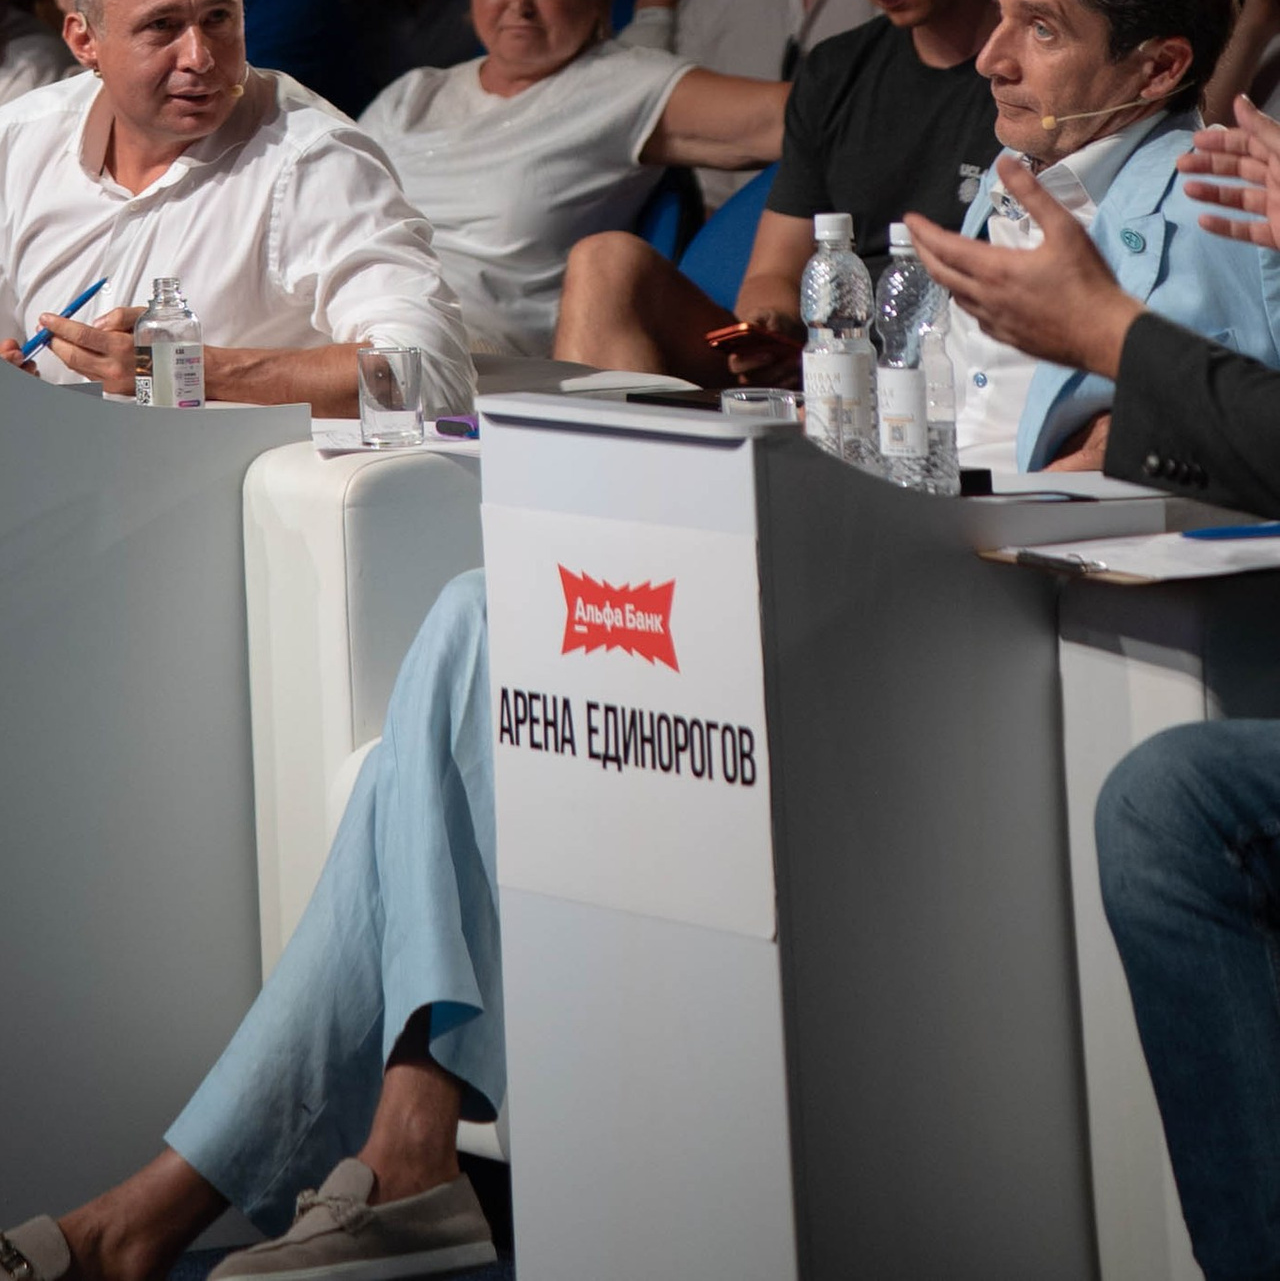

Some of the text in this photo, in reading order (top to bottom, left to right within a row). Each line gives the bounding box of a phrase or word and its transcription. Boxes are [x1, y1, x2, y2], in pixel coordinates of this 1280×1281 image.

[960, 163, 988, 178] UCL
[574, 595, 665, 635] Альфа Банк
[499, 686, 757, 787] АРЕНА ЕДИНОРОГОВ
